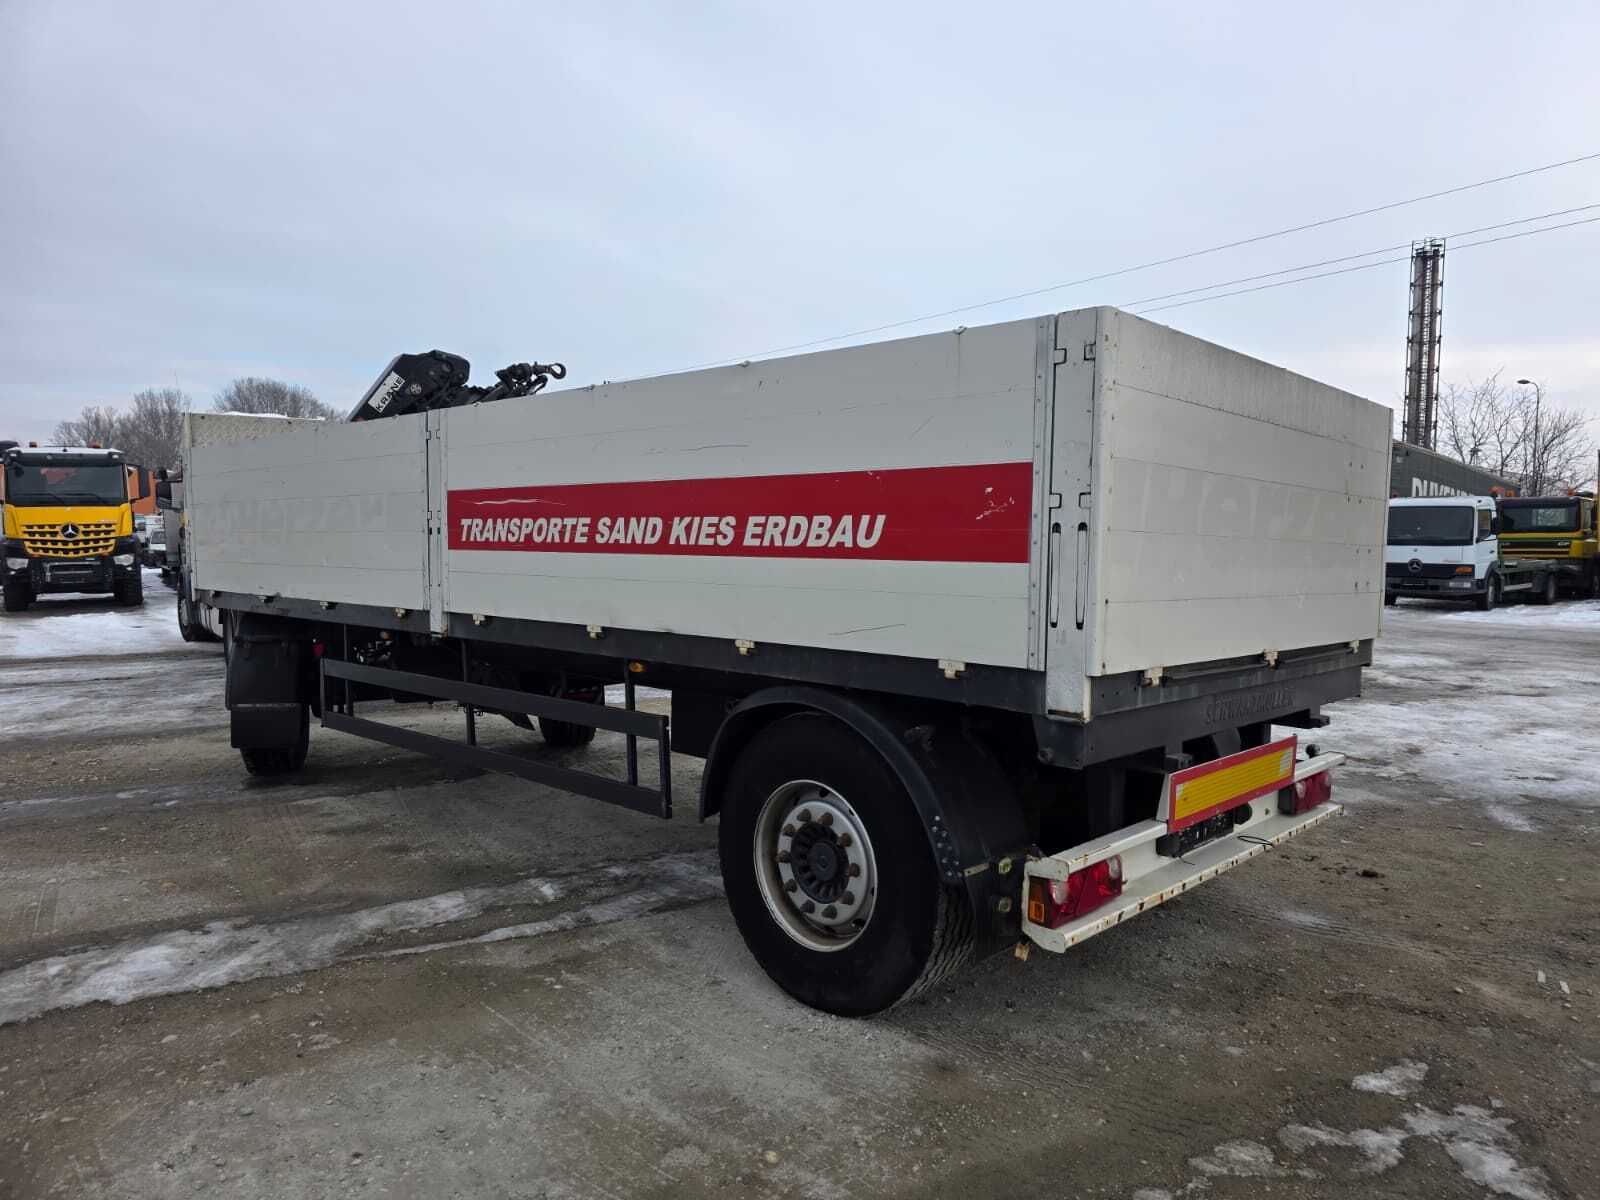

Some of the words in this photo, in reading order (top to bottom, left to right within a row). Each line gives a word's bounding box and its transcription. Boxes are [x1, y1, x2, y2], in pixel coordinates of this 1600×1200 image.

[460, 517, 591, 544] TRANSPORTE
[595, 516, 663, 545] SAND
[668, 516, 737, 546] KIES
[742, 514, 887, 549] ERDBAU
